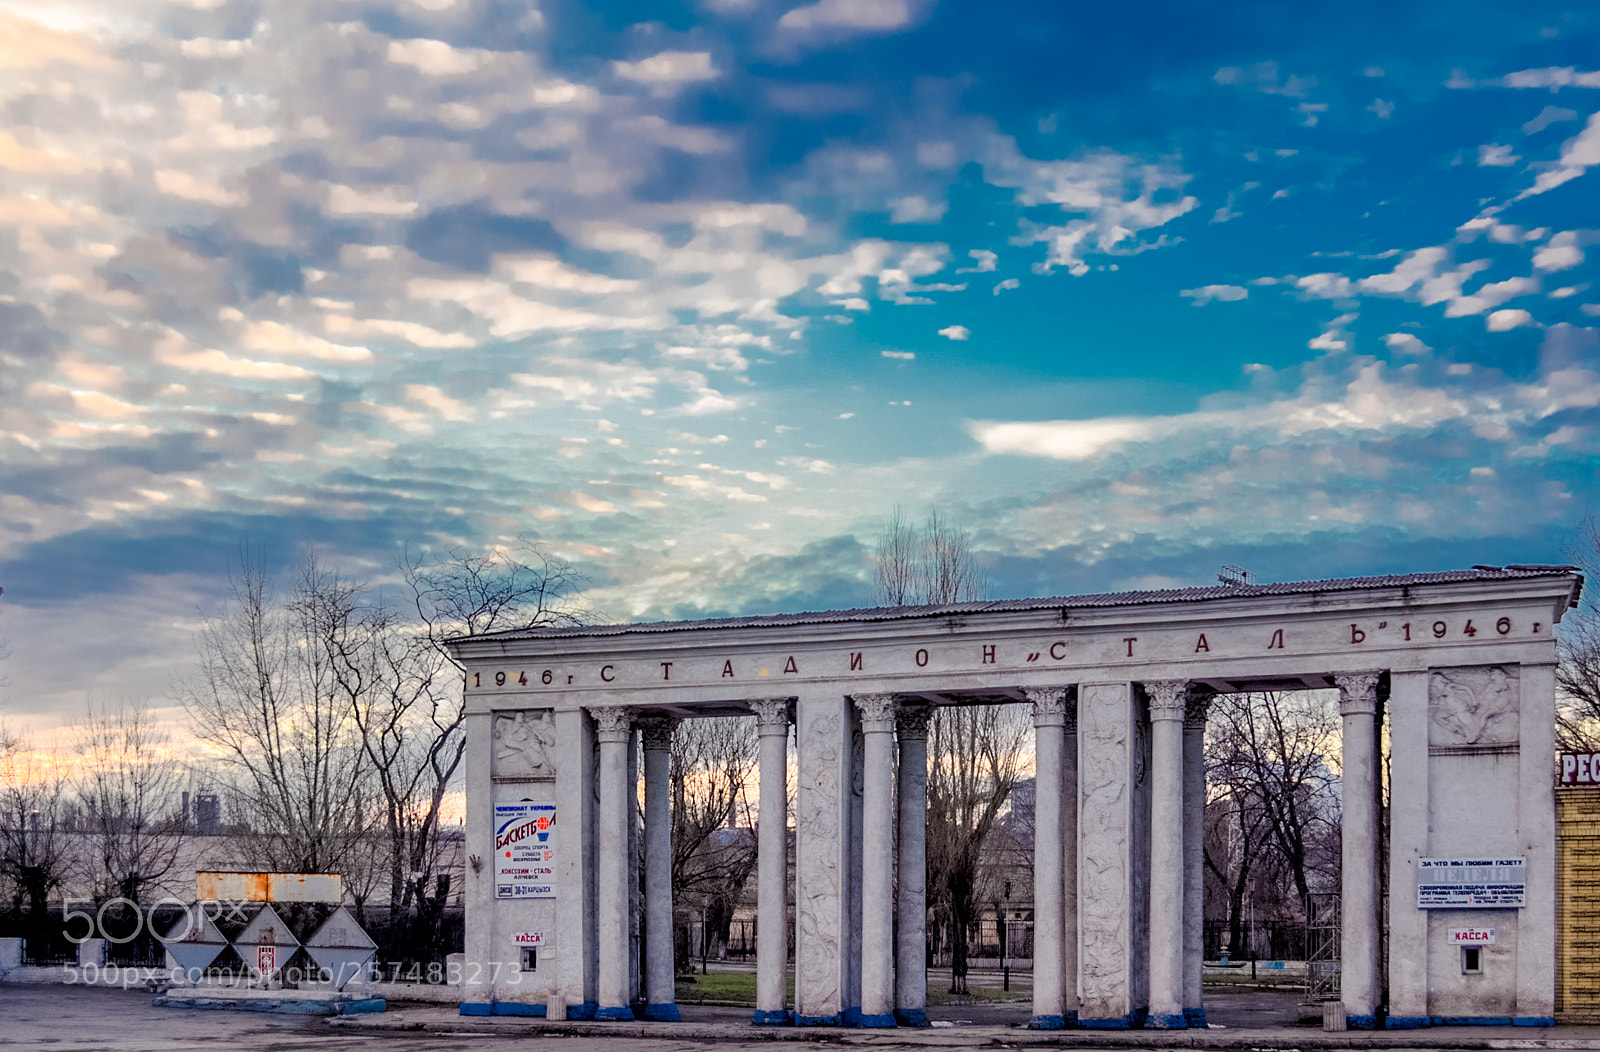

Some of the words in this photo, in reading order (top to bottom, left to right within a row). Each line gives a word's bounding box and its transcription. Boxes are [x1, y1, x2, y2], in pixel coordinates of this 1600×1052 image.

[473, 669, 553, 687] 1946
[600, 645, 996, 682] СТАДИОН
[1402, 617, 1511, 641] 1946
[1455, 932, 1488, 940] КАССА
